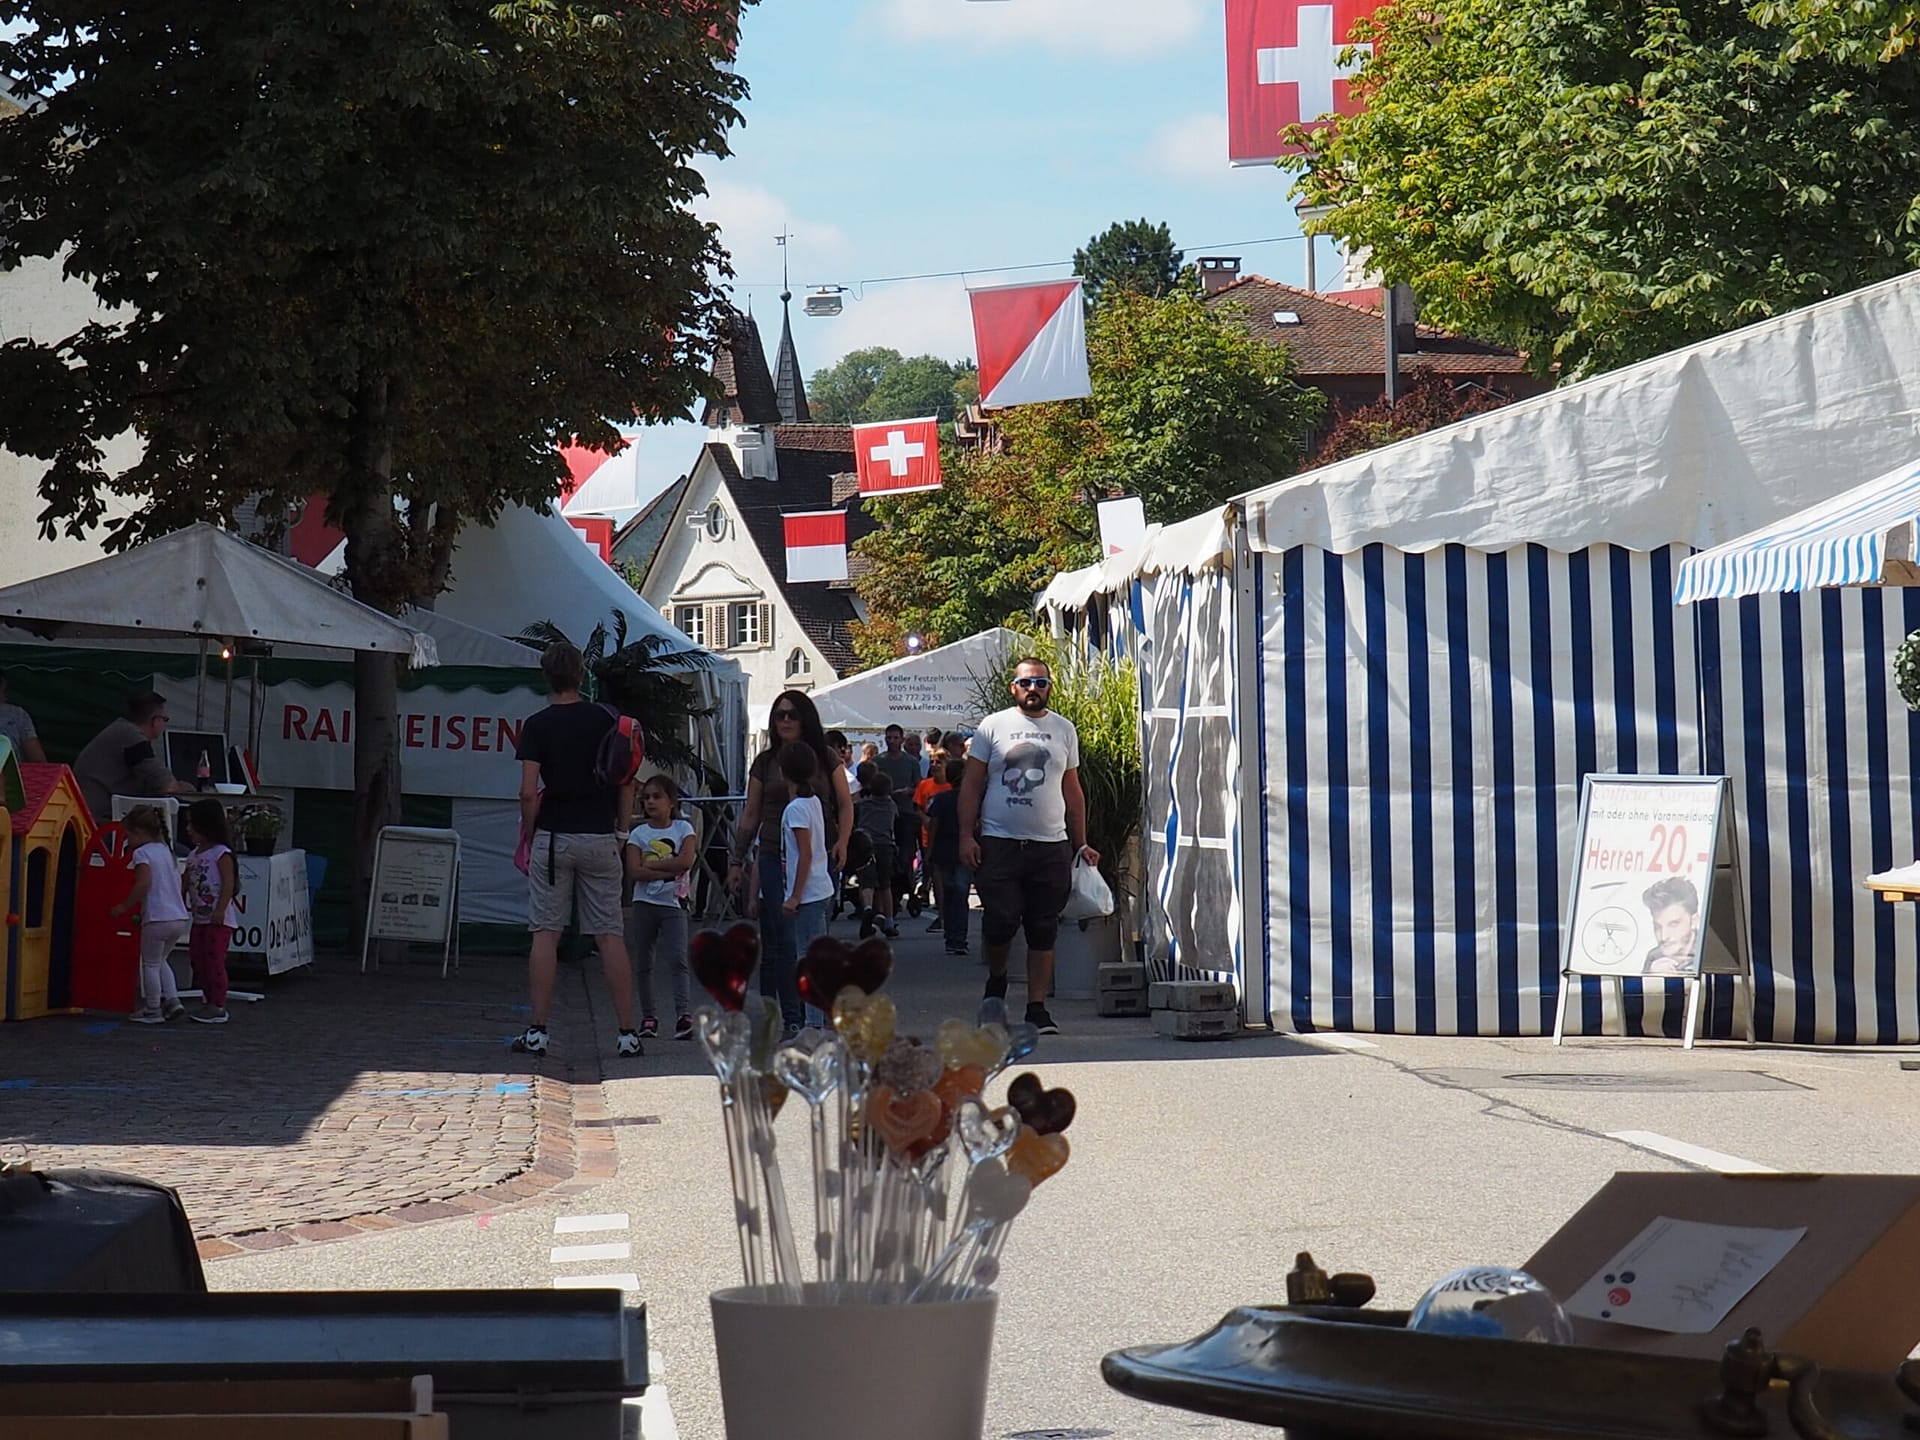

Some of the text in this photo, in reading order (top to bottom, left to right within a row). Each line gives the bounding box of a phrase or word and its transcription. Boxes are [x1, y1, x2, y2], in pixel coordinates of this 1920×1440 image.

[888, 674, 911, 682] Keller
[905, 694, 919, 702] 777
[888, 703, 964, 711] www.keller-zelt.ch
[283, 704, 523, 752] RAIEISEN
[1592, 808, 1714, 825] mit oder ohne Voranmeldung
[1587, 837, 1644, 871] Herren
